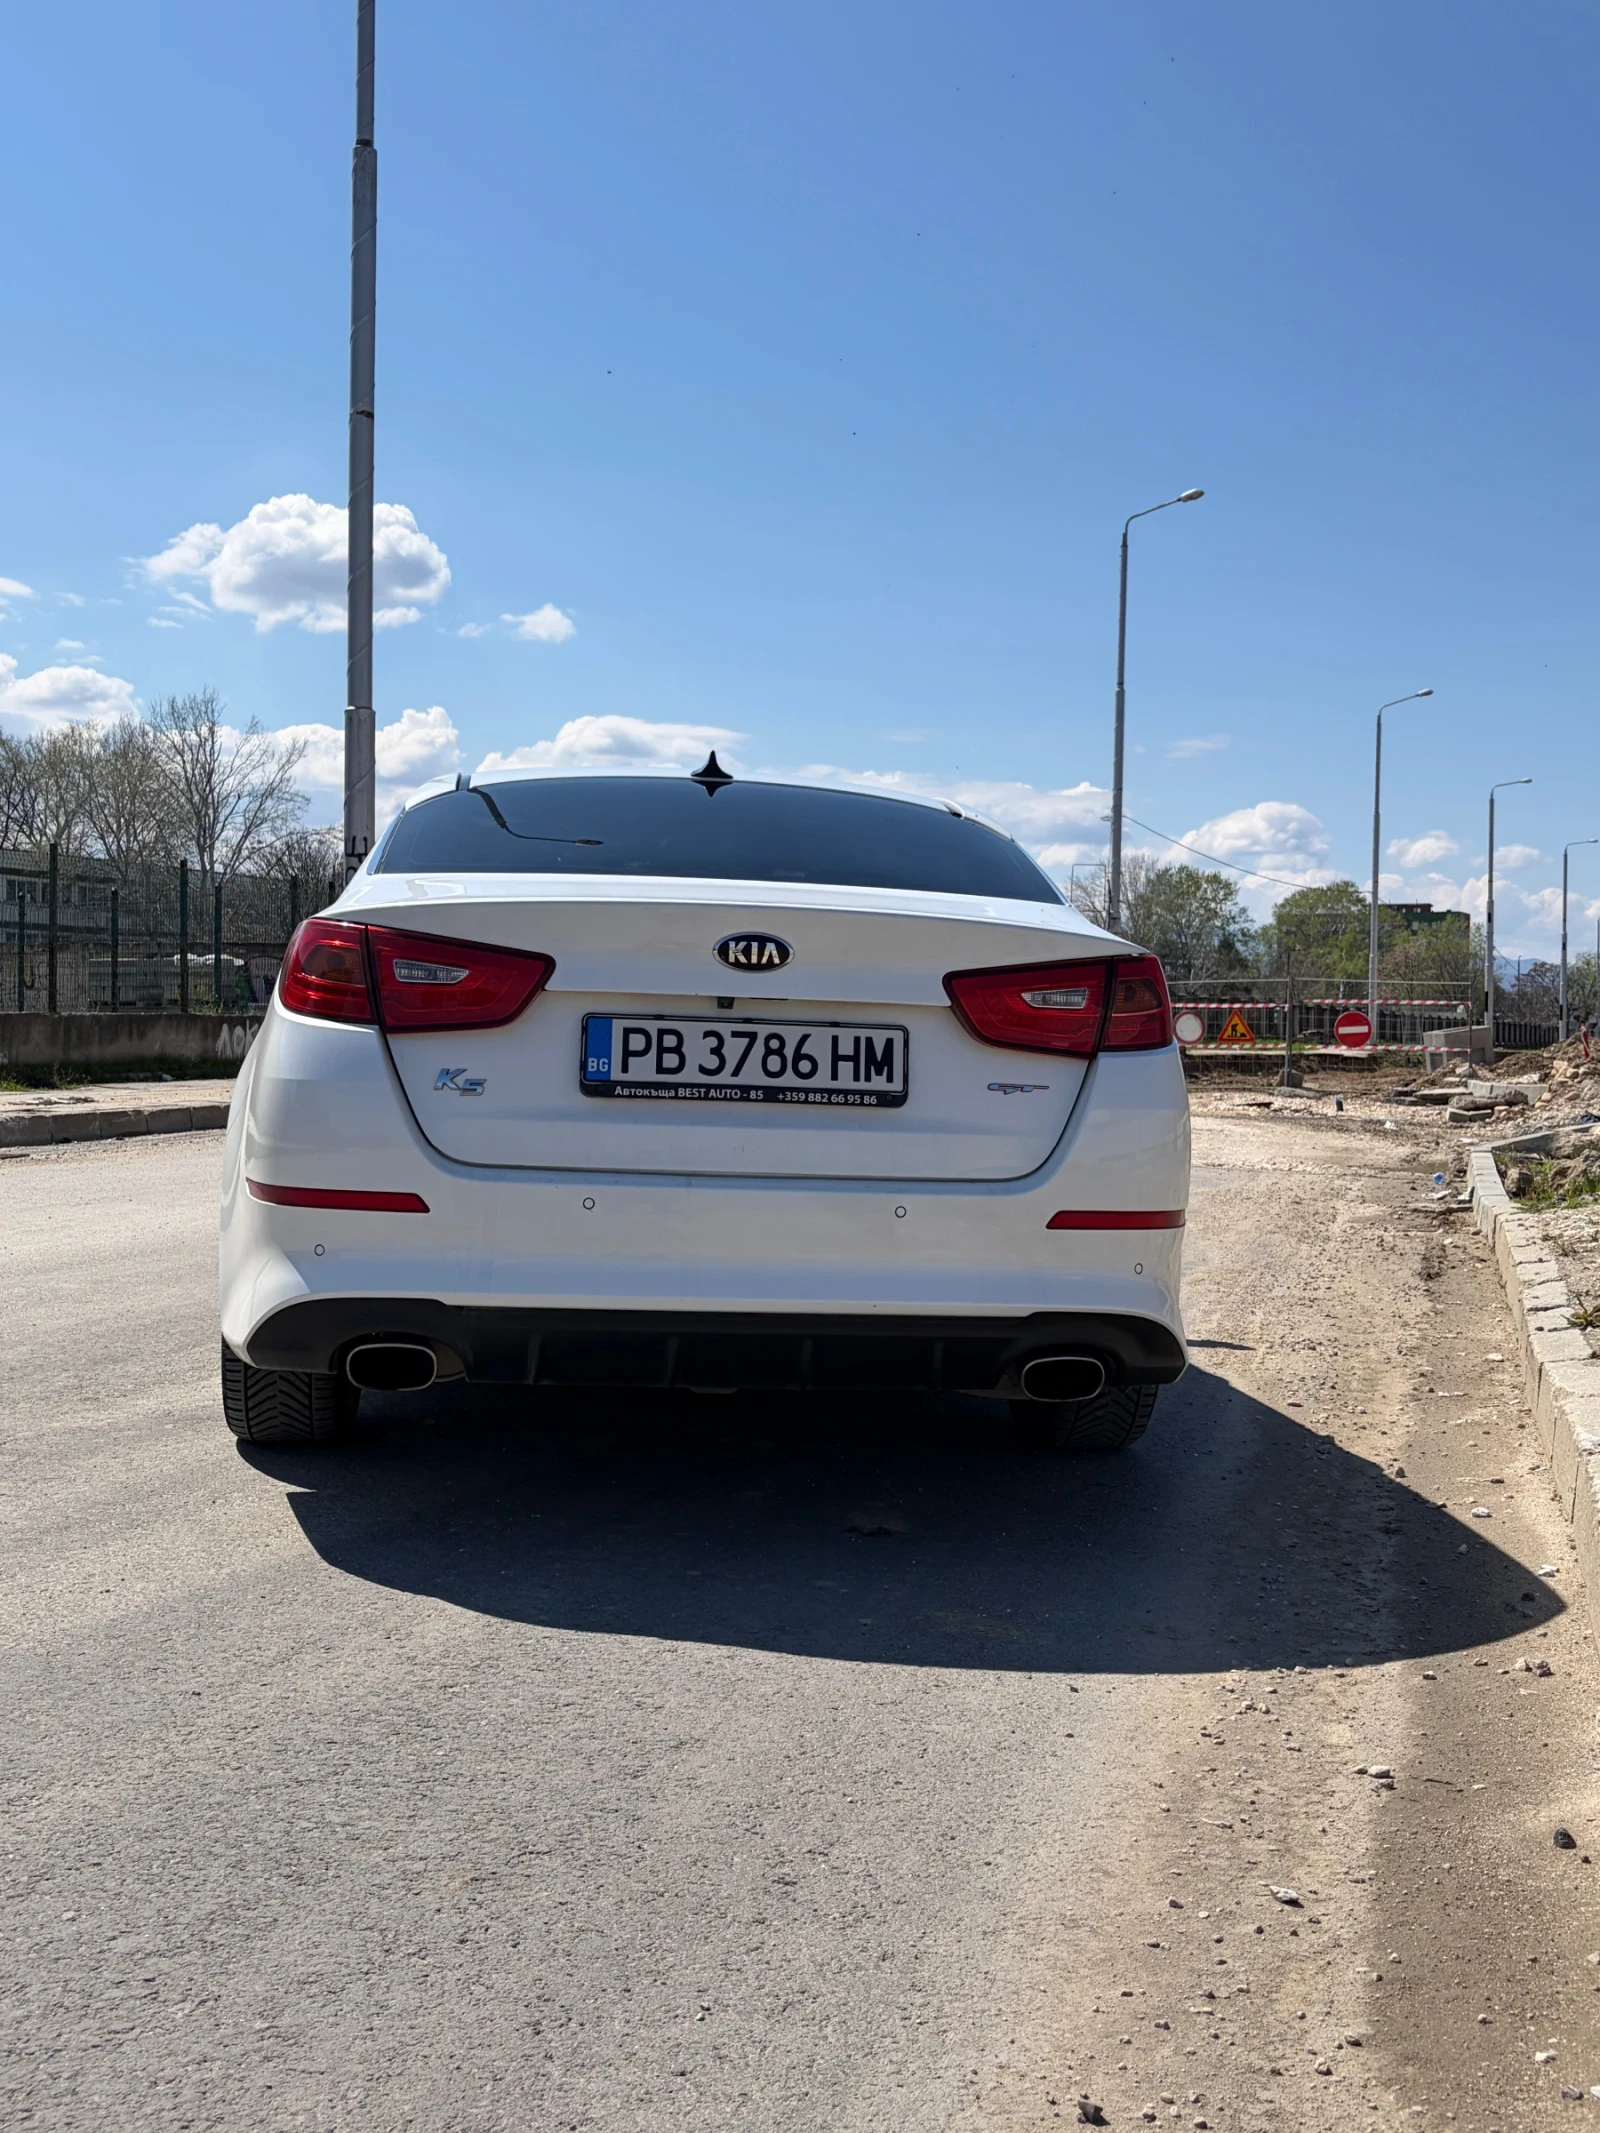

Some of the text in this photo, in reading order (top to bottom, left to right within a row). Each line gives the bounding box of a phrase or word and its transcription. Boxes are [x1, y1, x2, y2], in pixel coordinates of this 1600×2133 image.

[728, 940, 781, 965] KIA
[587, 1057, 609, 1072] BG
[698, 1029, 819, 1080] 3786
[433, 1068, 487, 1096] K5
[614, 1085, 676, 1098] Автокъща
[677, 1087, 706, 1098] BEST
[708, 1089, 741, 1099] AUTO
[749, 1090, 764, 1100] 85
[777, 1092, 878, 1105] +359 882 66 95 86
